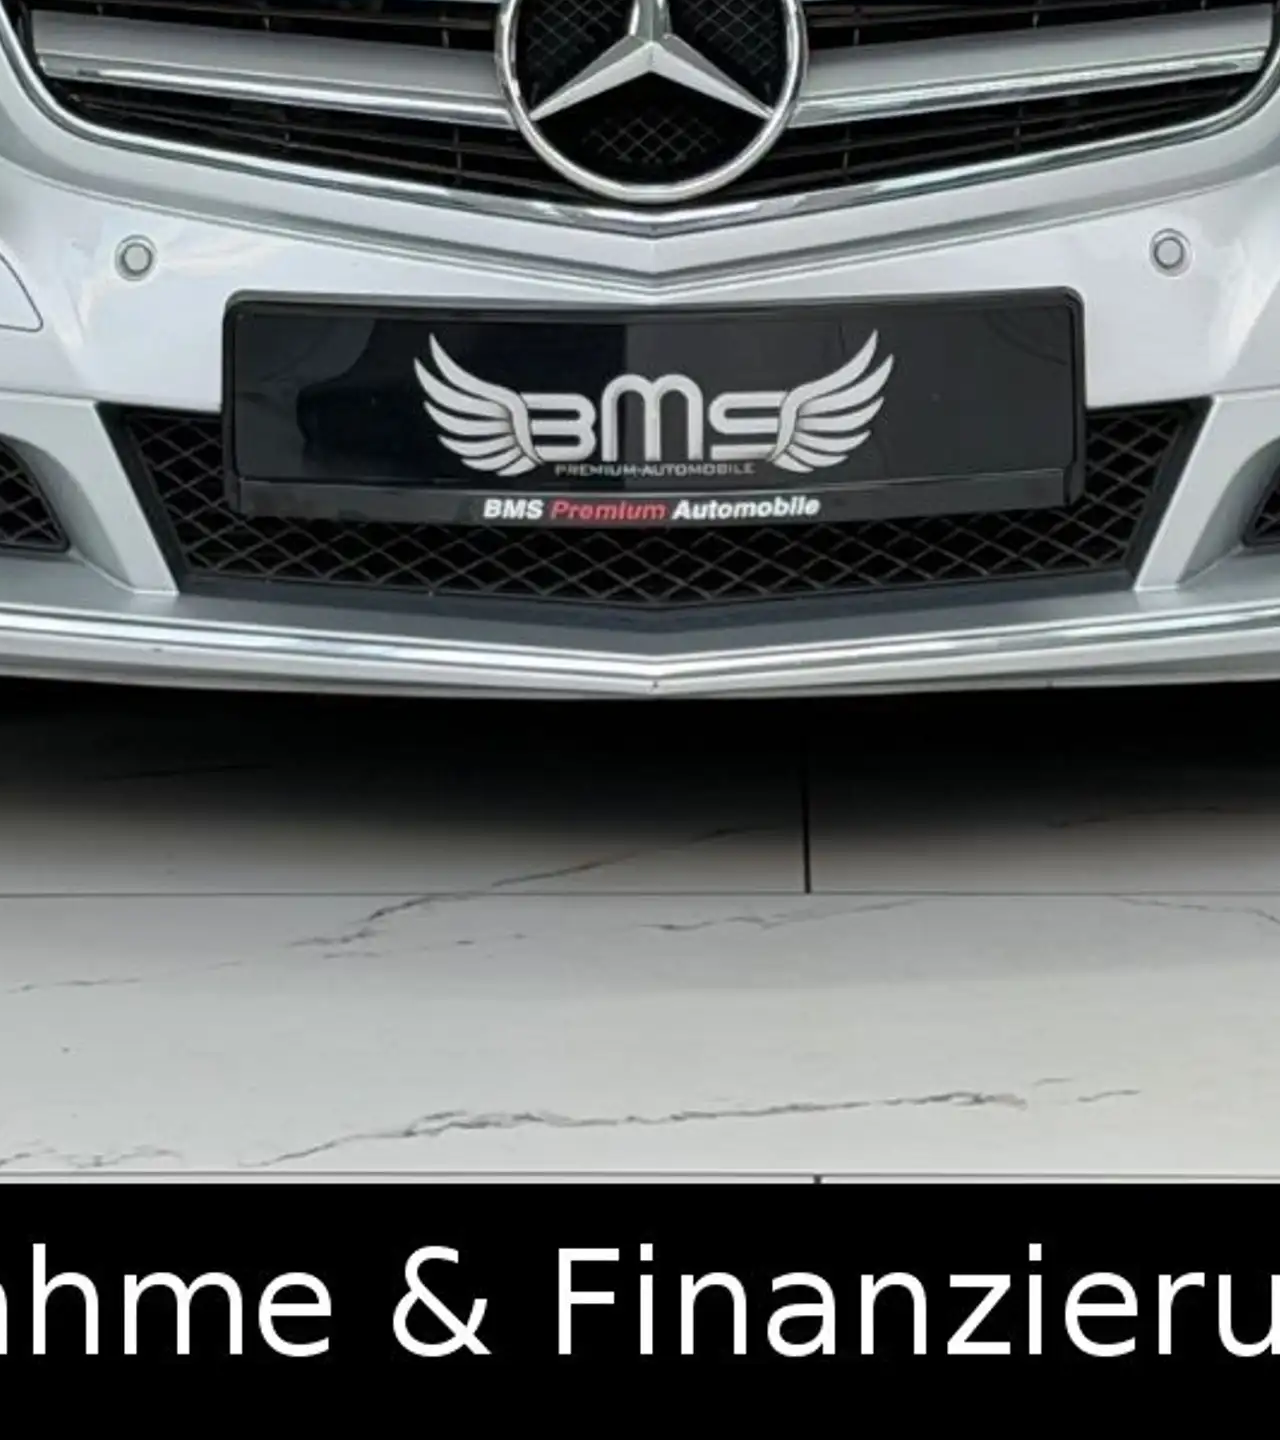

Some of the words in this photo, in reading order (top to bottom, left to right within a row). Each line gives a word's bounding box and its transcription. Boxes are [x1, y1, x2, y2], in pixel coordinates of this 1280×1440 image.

[521, 374, 788, 462] BMS
[555, 462, 756, 477] PREMIUM-AUTOMOBILE
[484, 499, 543, 520] BMS
[550, 499, 667, 521] Premium
[672, 496, 821, 520] Automobile
